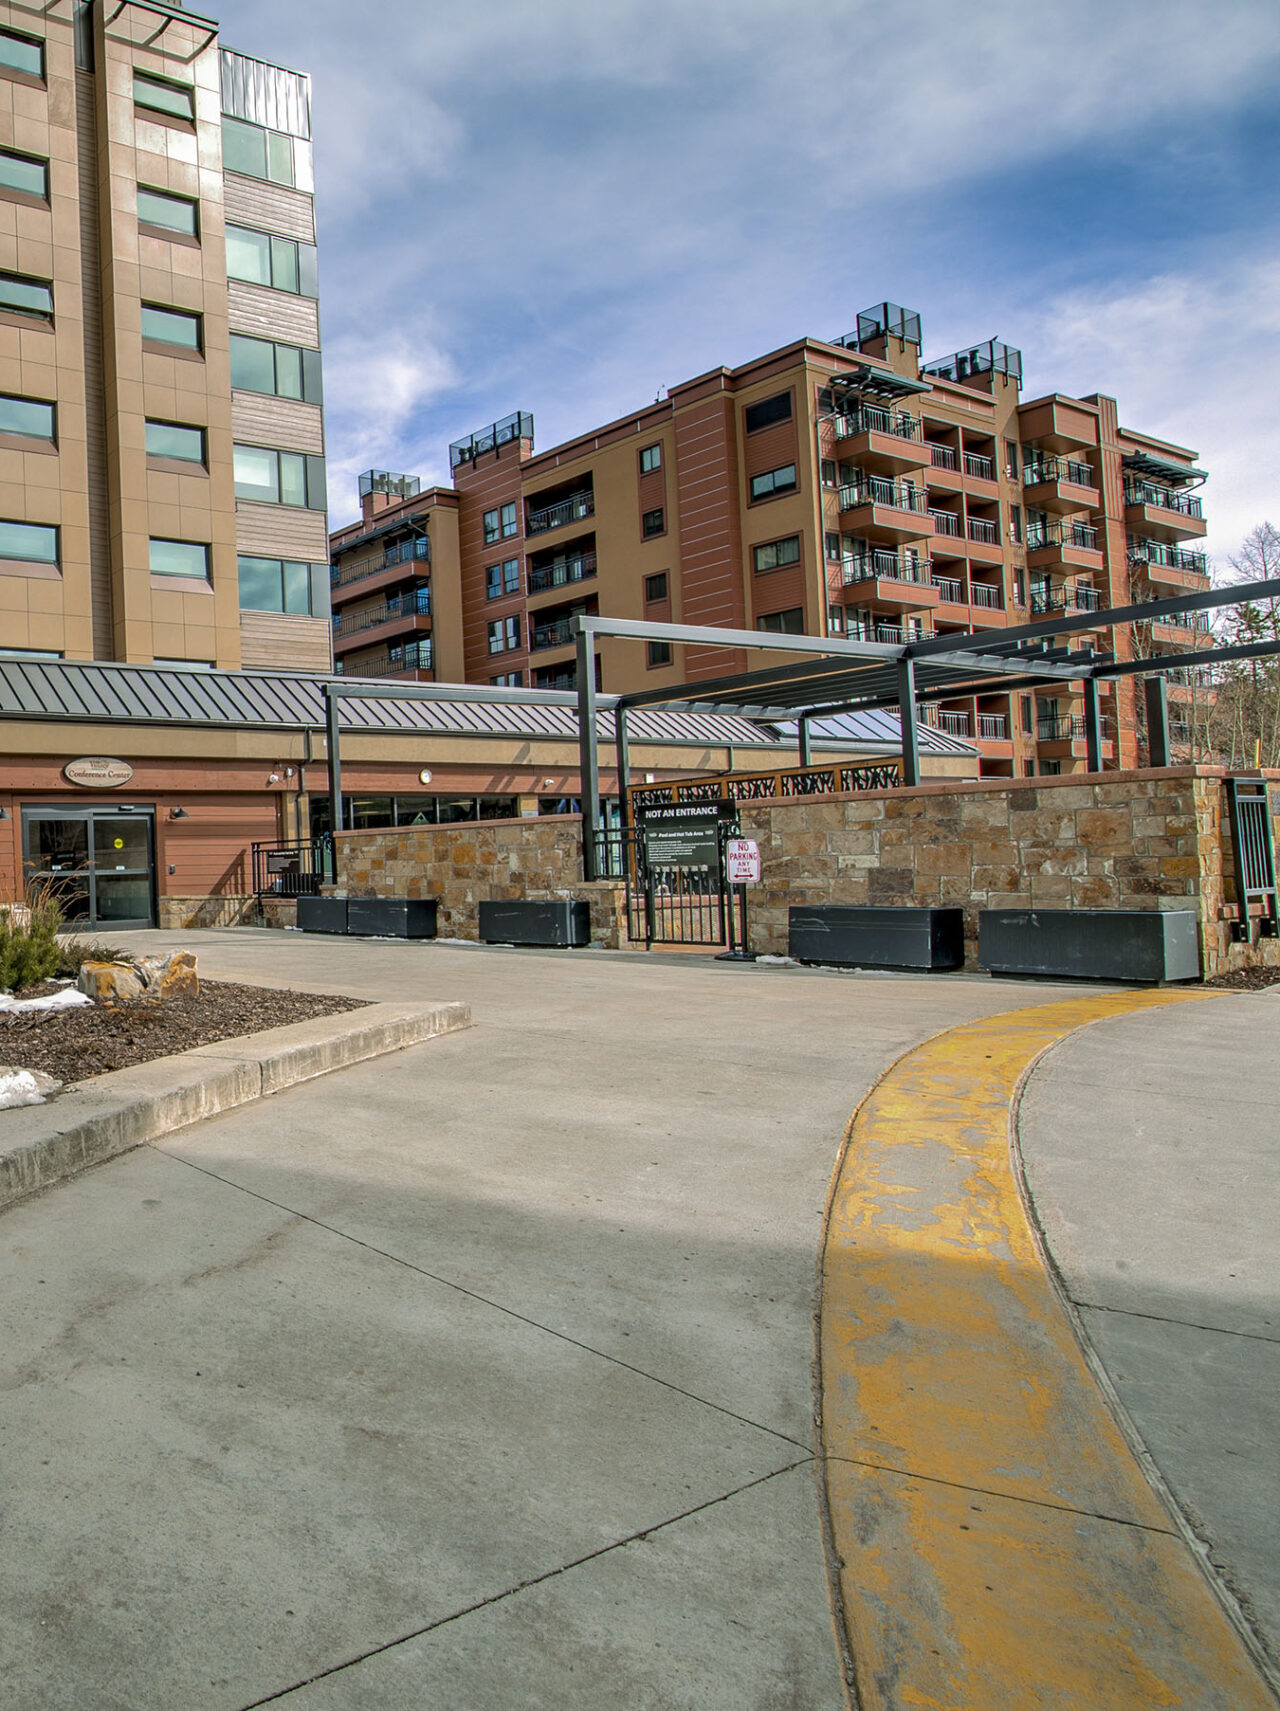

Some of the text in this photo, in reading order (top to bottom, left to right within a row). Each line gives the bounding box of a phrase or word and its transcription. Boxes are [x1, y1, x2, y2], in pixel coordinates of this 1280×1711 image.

[68, 770, 131, 778] Conference Center
[645, 806, 718, 818] NOT AN ENTRANCE
[738, 843, 749, 851] NO
[730, 852, 757, 860] PARKING
